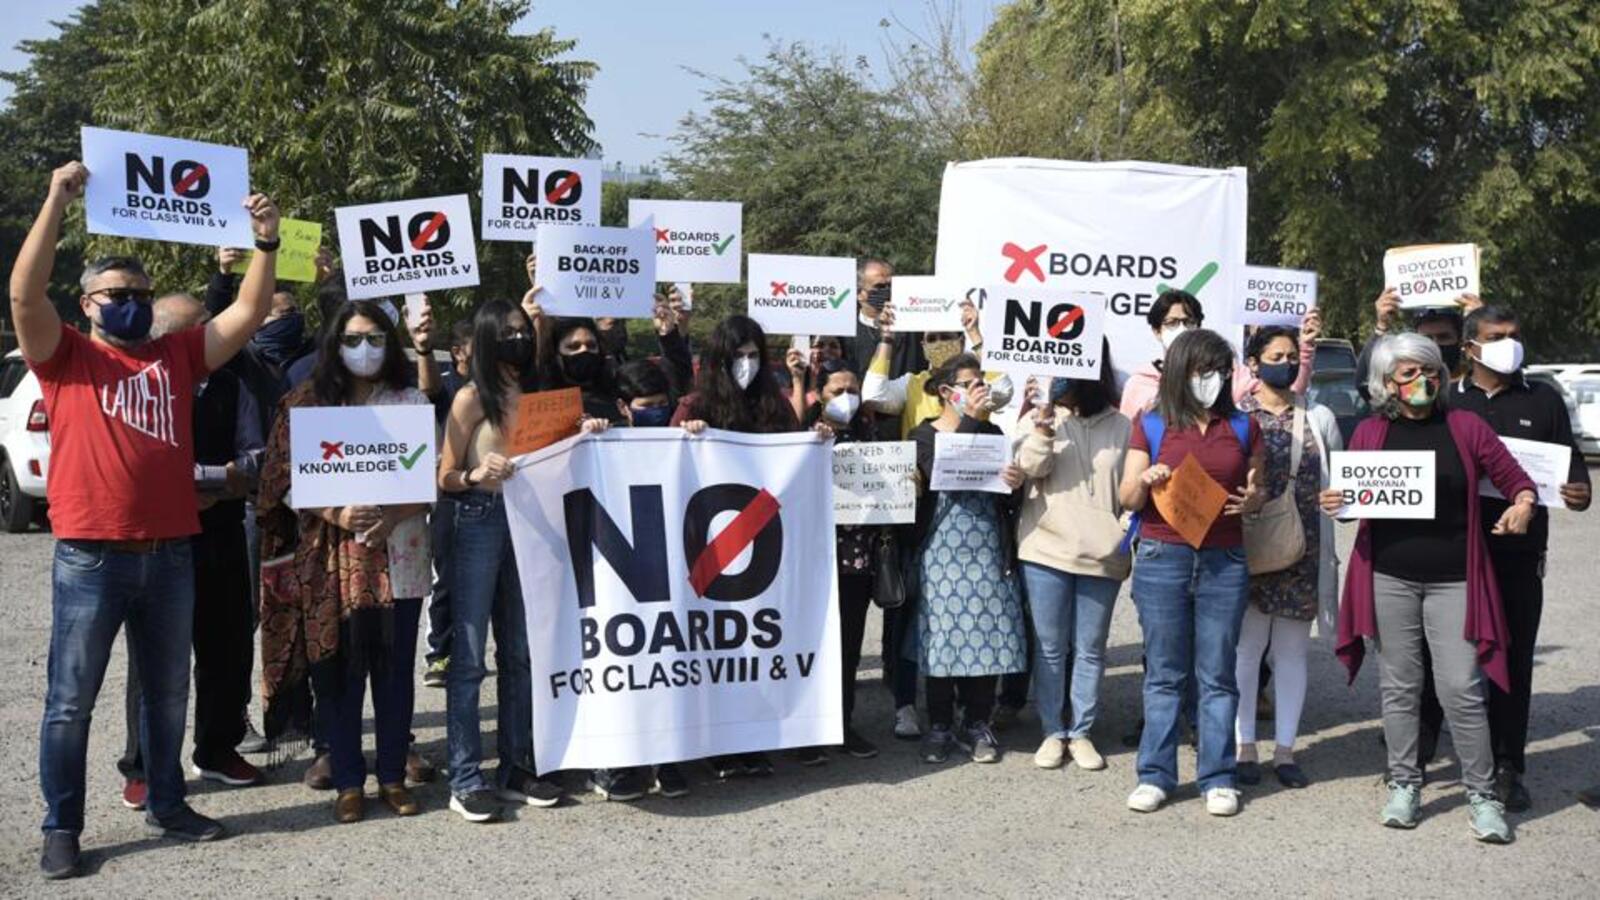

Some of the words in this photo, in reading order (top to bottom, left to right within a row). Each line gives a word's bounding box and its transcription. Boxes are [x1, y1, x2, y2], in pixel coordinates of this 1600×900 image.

[125, 152, 210, 199] NO
[502, 167, 582, 206] NO
[127, 193, 212, 216] BOARDS
[501, 205, 582, 222] BOARDS
[112, 207, 138, 219] FOR
[140, 210, 180, 223] CLASS
[182, 216, 204, 226] VIII
[207, 218, 215, 227] &
[218, 219, 227, 228] V
[488, 219, 511, 229] FOR
[360, 211, 450, 257] NO
[670, 231, 720, 242] BOARDS
[574, 244, 628, 255] BACK-OFF
[365, 251, 455, 274] BOARDS
[558, 256, 640, 274] BOARDS
[1049, 253, 1177, 280] BOARDS
[1398, 256, 1466, 274] BOYCOTT
[352, 276, 378, 287] FOR
[381, 270, 421, 284] CLASS
[424, 267, 448, 278] VIII
[451, 266, 459, 275] &
[462, 264, 471, 274] V
[574, 284, 597, 298] VIII
[601, 286, 611, 299] &
[615, 287, 624, 299] V
[788, 285, 836, 296] BOARDS
[1248, 279, 1307, 294] BOYCOTT
[1400, 276, 1468, 296] BOARD
[754, 298, 827, 309] KNOWLEDGE
[1245, 298, 1307, 316] BOARD
[1003, 299, 1085, 340] NO
[1002, 338, 1083, 356] BOARDS
[987, 351, 1011, 361] FOR
[1012, 353, 1050, 364] CLASS
[1053, 356, 1073, 366] VIII
[1076, 359, 1084, 367] &
[1087, 359, 1096, 368] V
[344, 443, 409, 456] BOARDS
[299, 460, 397, 474] KNOWLEDGE
[1342, 466, 1422, 479] BOYCOTT
[1342, 489, 1423, 505] BOARD
[562, 483, 783, 608] NO
[580, 608, 782, 661] BOARDS
[550, 668, 595, 699] FOR
[602, 659, 702, 693] CLASS
[707, 657, 759, 684] VIII
[769, 655, 787, 680] &
[796, 652, 815, 678] V
